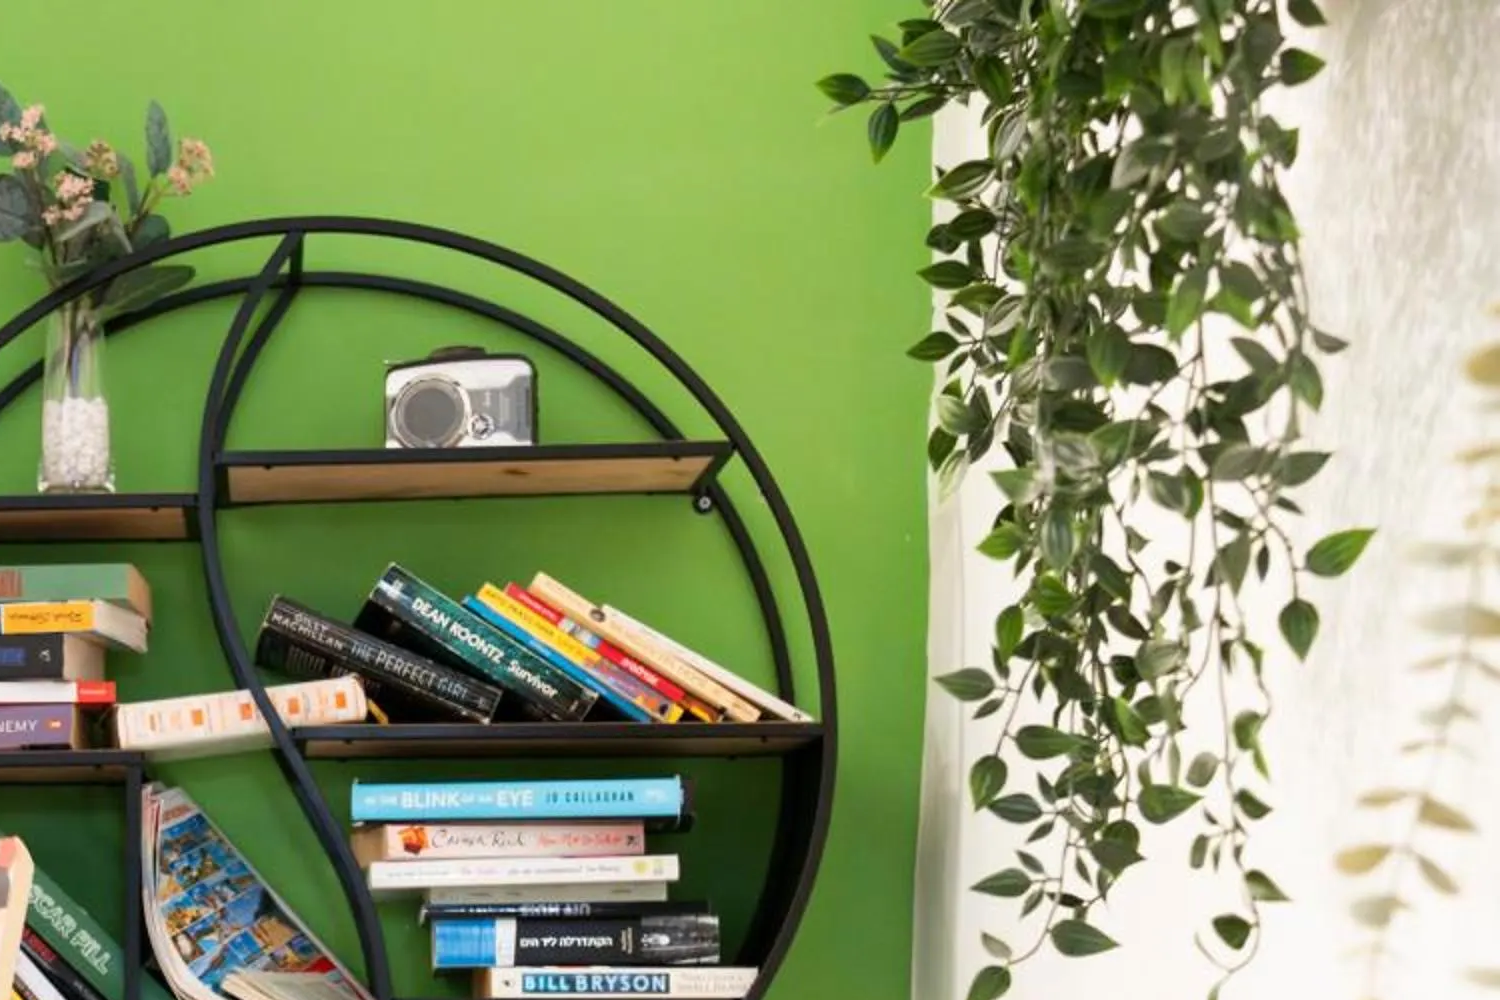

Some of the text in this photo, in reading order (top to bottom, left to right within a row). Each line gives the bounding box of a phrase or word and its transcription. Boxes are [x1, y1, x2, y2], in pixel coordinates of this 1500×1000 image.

[271, 613, 345, 650] MACMILLAN
[411, 596, 451, 630] DEAN
[449, 620, 506, 664] KOONTZ
[507, 658, 560, 699] Survivor
[350, 641, 470, 700] THE PERFECT GIRL
[400, 790, 461, 809] BLINK
[498, 789, 534, 808] EYE
[29, 884, 78, 939] SCAR
[69, 929, 112, 976] PILL
[523, 974, 570, 992] BILL
[575, 973, 668, 992] BRYSON
